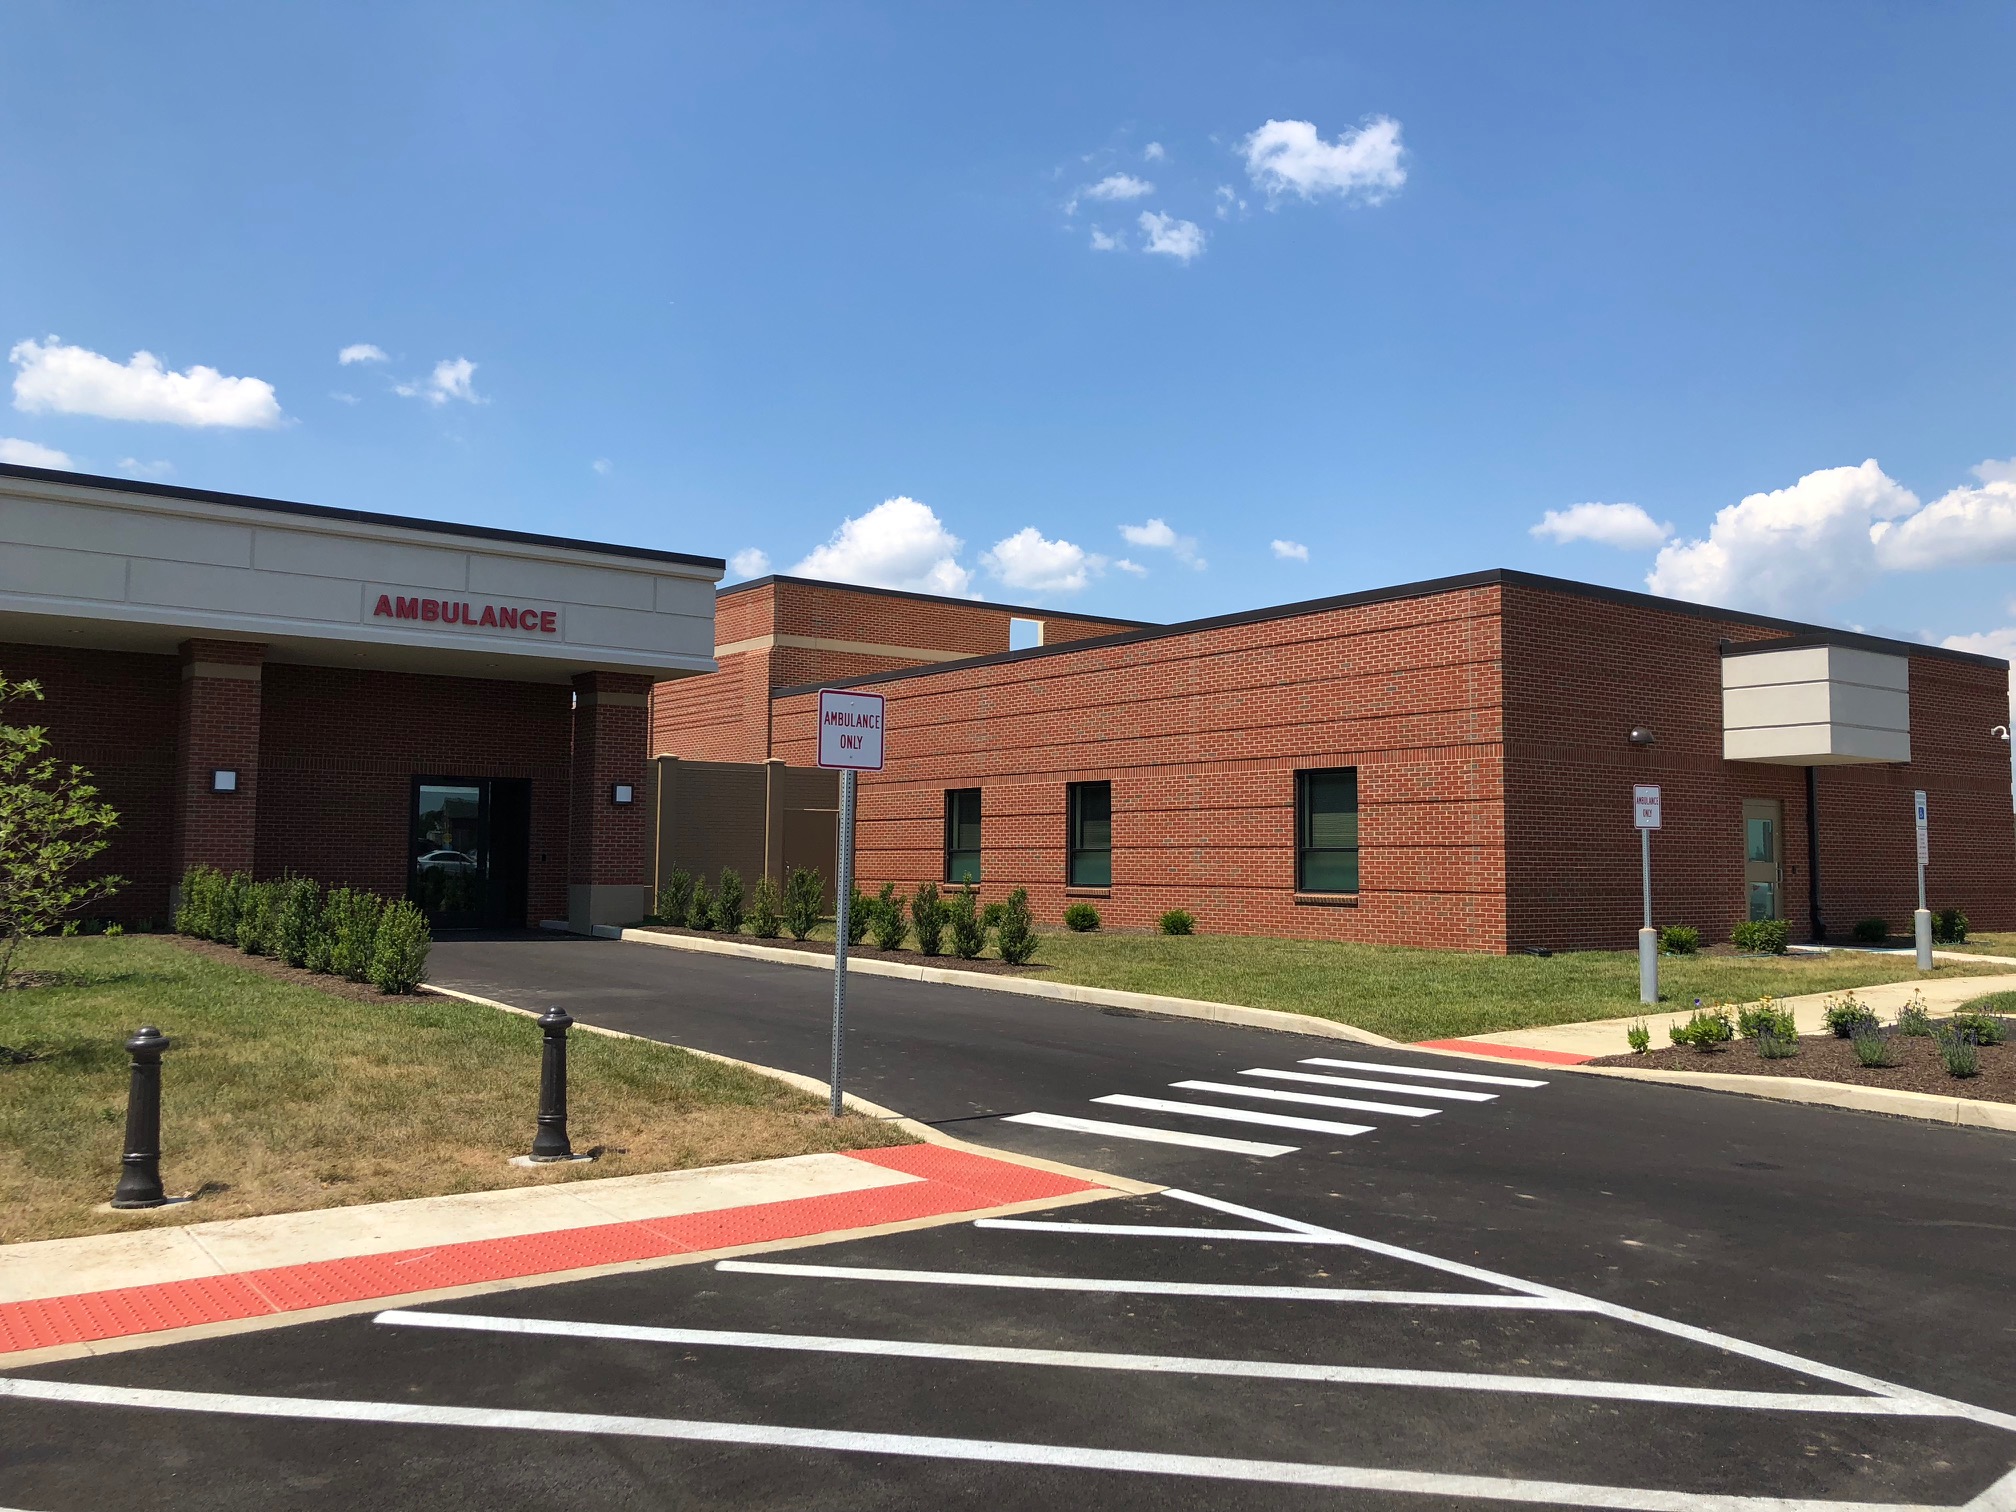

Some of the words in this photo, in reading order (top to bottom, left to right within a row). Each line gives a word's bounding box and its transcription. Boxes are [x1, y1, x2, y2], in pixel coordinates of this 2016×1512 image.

[373, 594, 557, 633] AMBULANCE
[824, 710, 881, 730] AMBULANCE
[840, 734, 863, 750] ONLY
